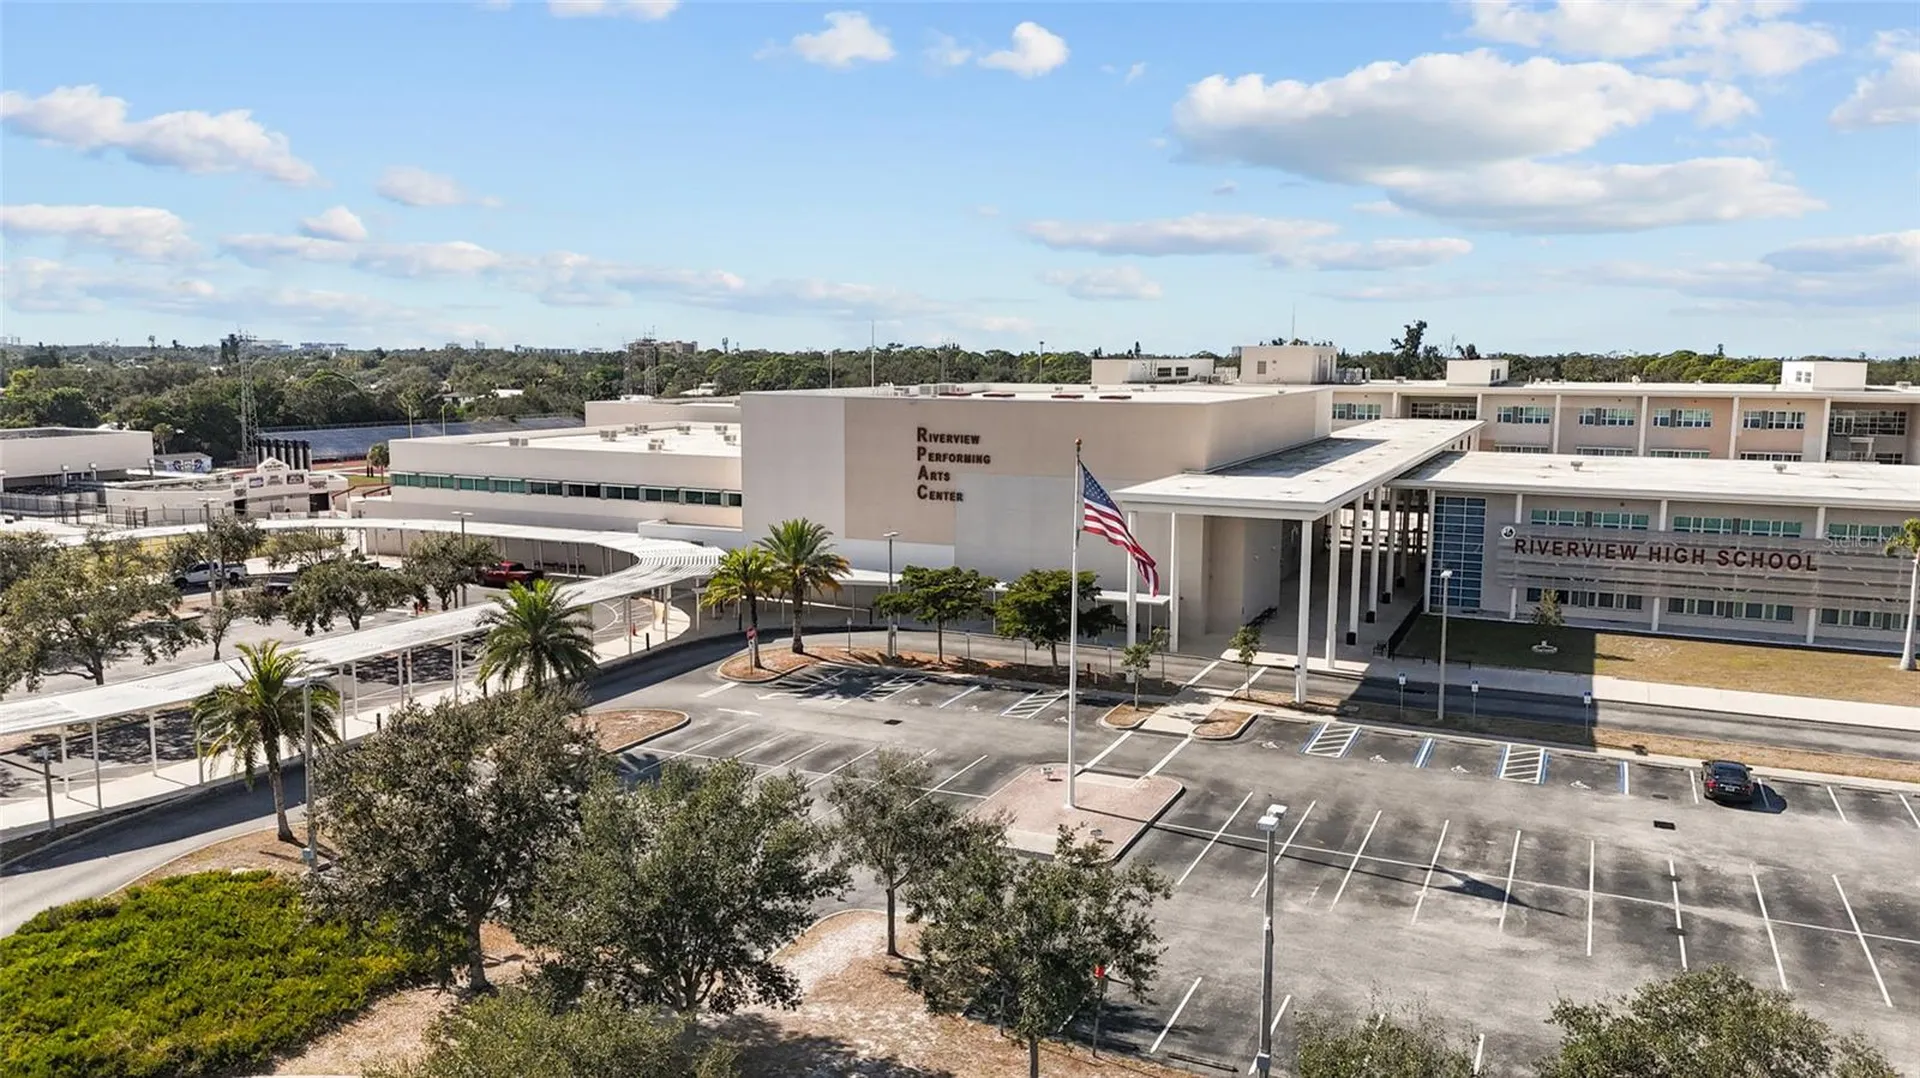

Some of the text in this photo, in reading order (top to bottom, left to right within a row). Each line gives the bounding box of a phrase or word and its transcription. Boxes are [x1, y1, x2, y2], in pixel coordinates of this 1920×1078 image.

[917, 427, 980, 444] RIVERVIEW
[917, 446, 991, 464] PERFORMING
[917, 465, 951, 481] ARTS
[917, 484, 964, 502] CENTER
[1514, 538, 1818, 571] RIVERVIEW HIGH SCHOOL
